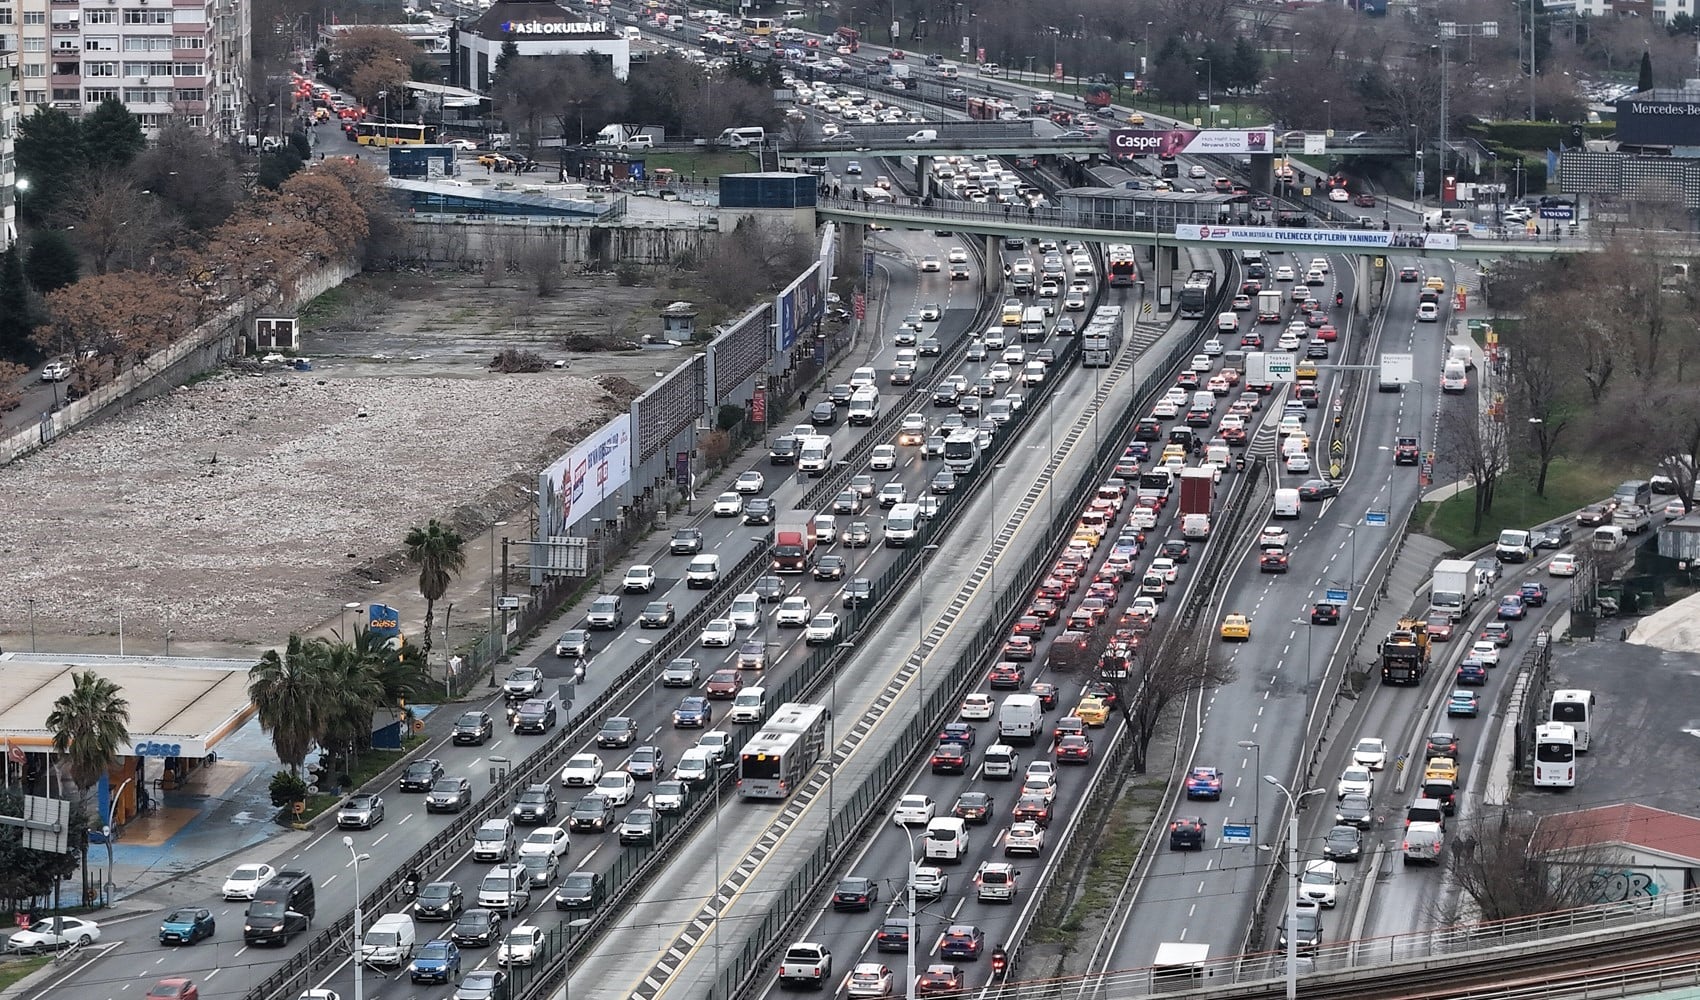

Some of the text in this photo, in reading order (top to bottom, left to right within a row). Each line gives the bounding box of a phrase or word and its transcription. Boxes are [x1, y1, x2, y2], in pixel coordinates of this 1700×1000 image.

[1116, 134, 1164, 150] Casper
[1543, 210, 1570, 218] VOLVO
[1275, 231, 1312, 241] EVLENECEK
[1313, 231, 1347, 242] ÇİFTLERİN
[1349, 234, 1388, 243] YANINDAYIZ
